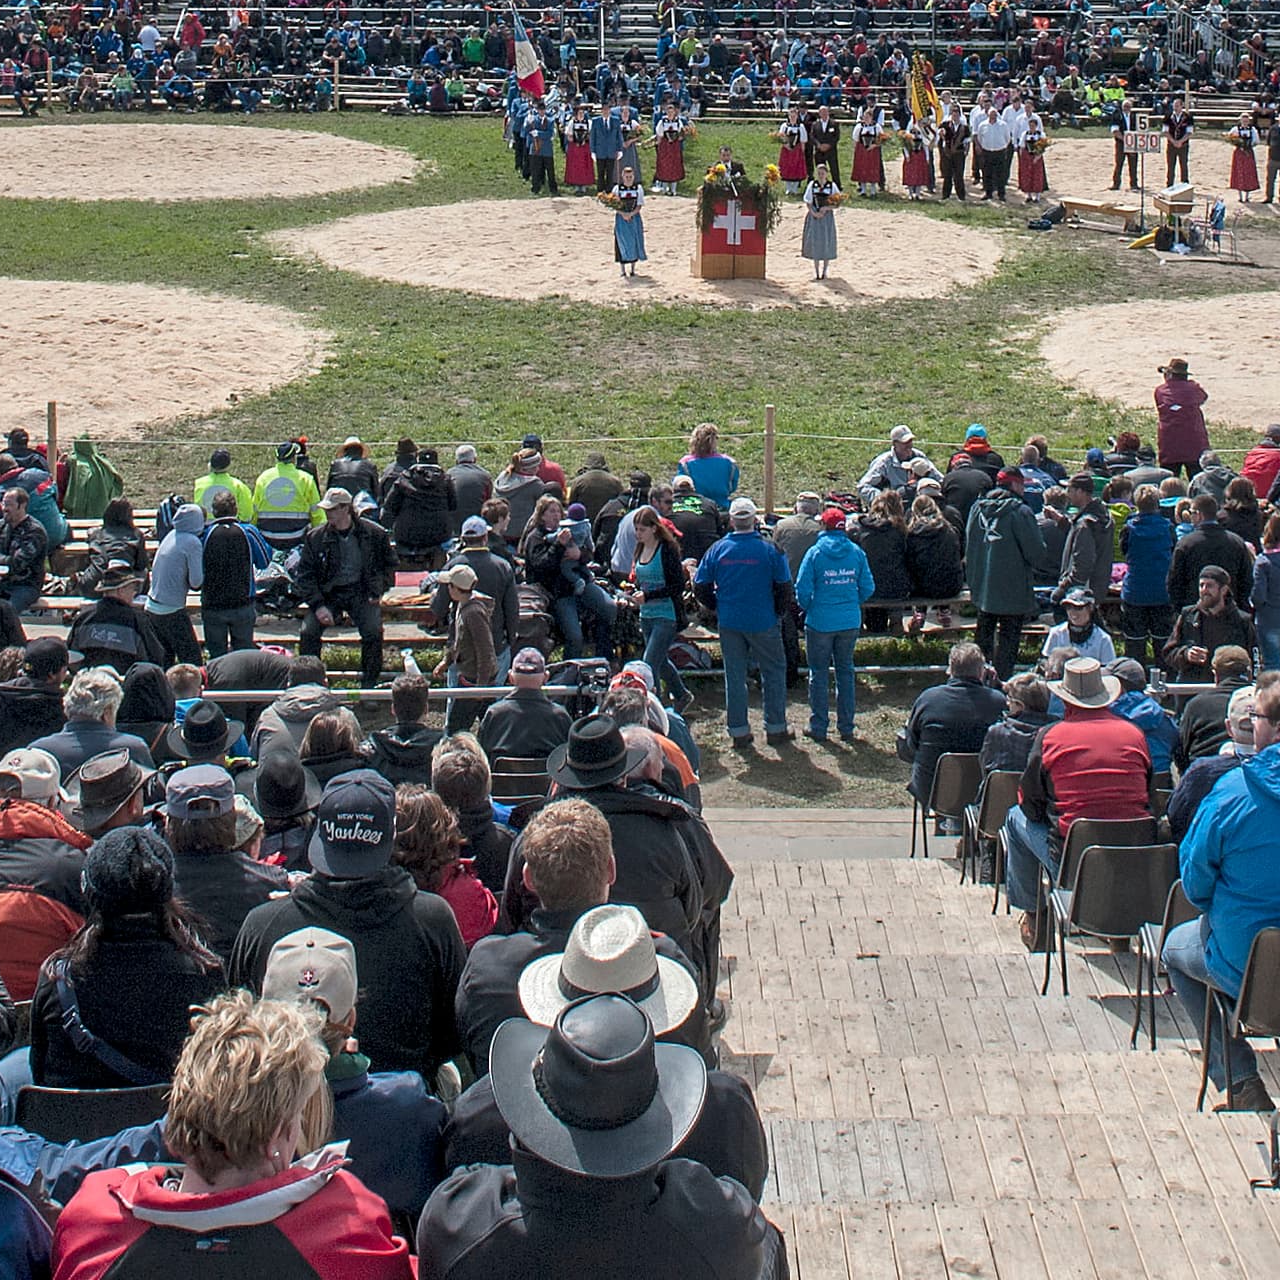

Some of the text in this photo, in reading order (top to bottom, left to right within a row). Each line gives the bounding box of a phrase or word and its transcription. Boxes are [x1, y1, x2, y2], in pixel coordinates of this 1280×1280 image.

[1139, 116, 1147, 130] 5
[355, 814, 375, 823] YORK
[322, 820, 383, 845] Yankees
